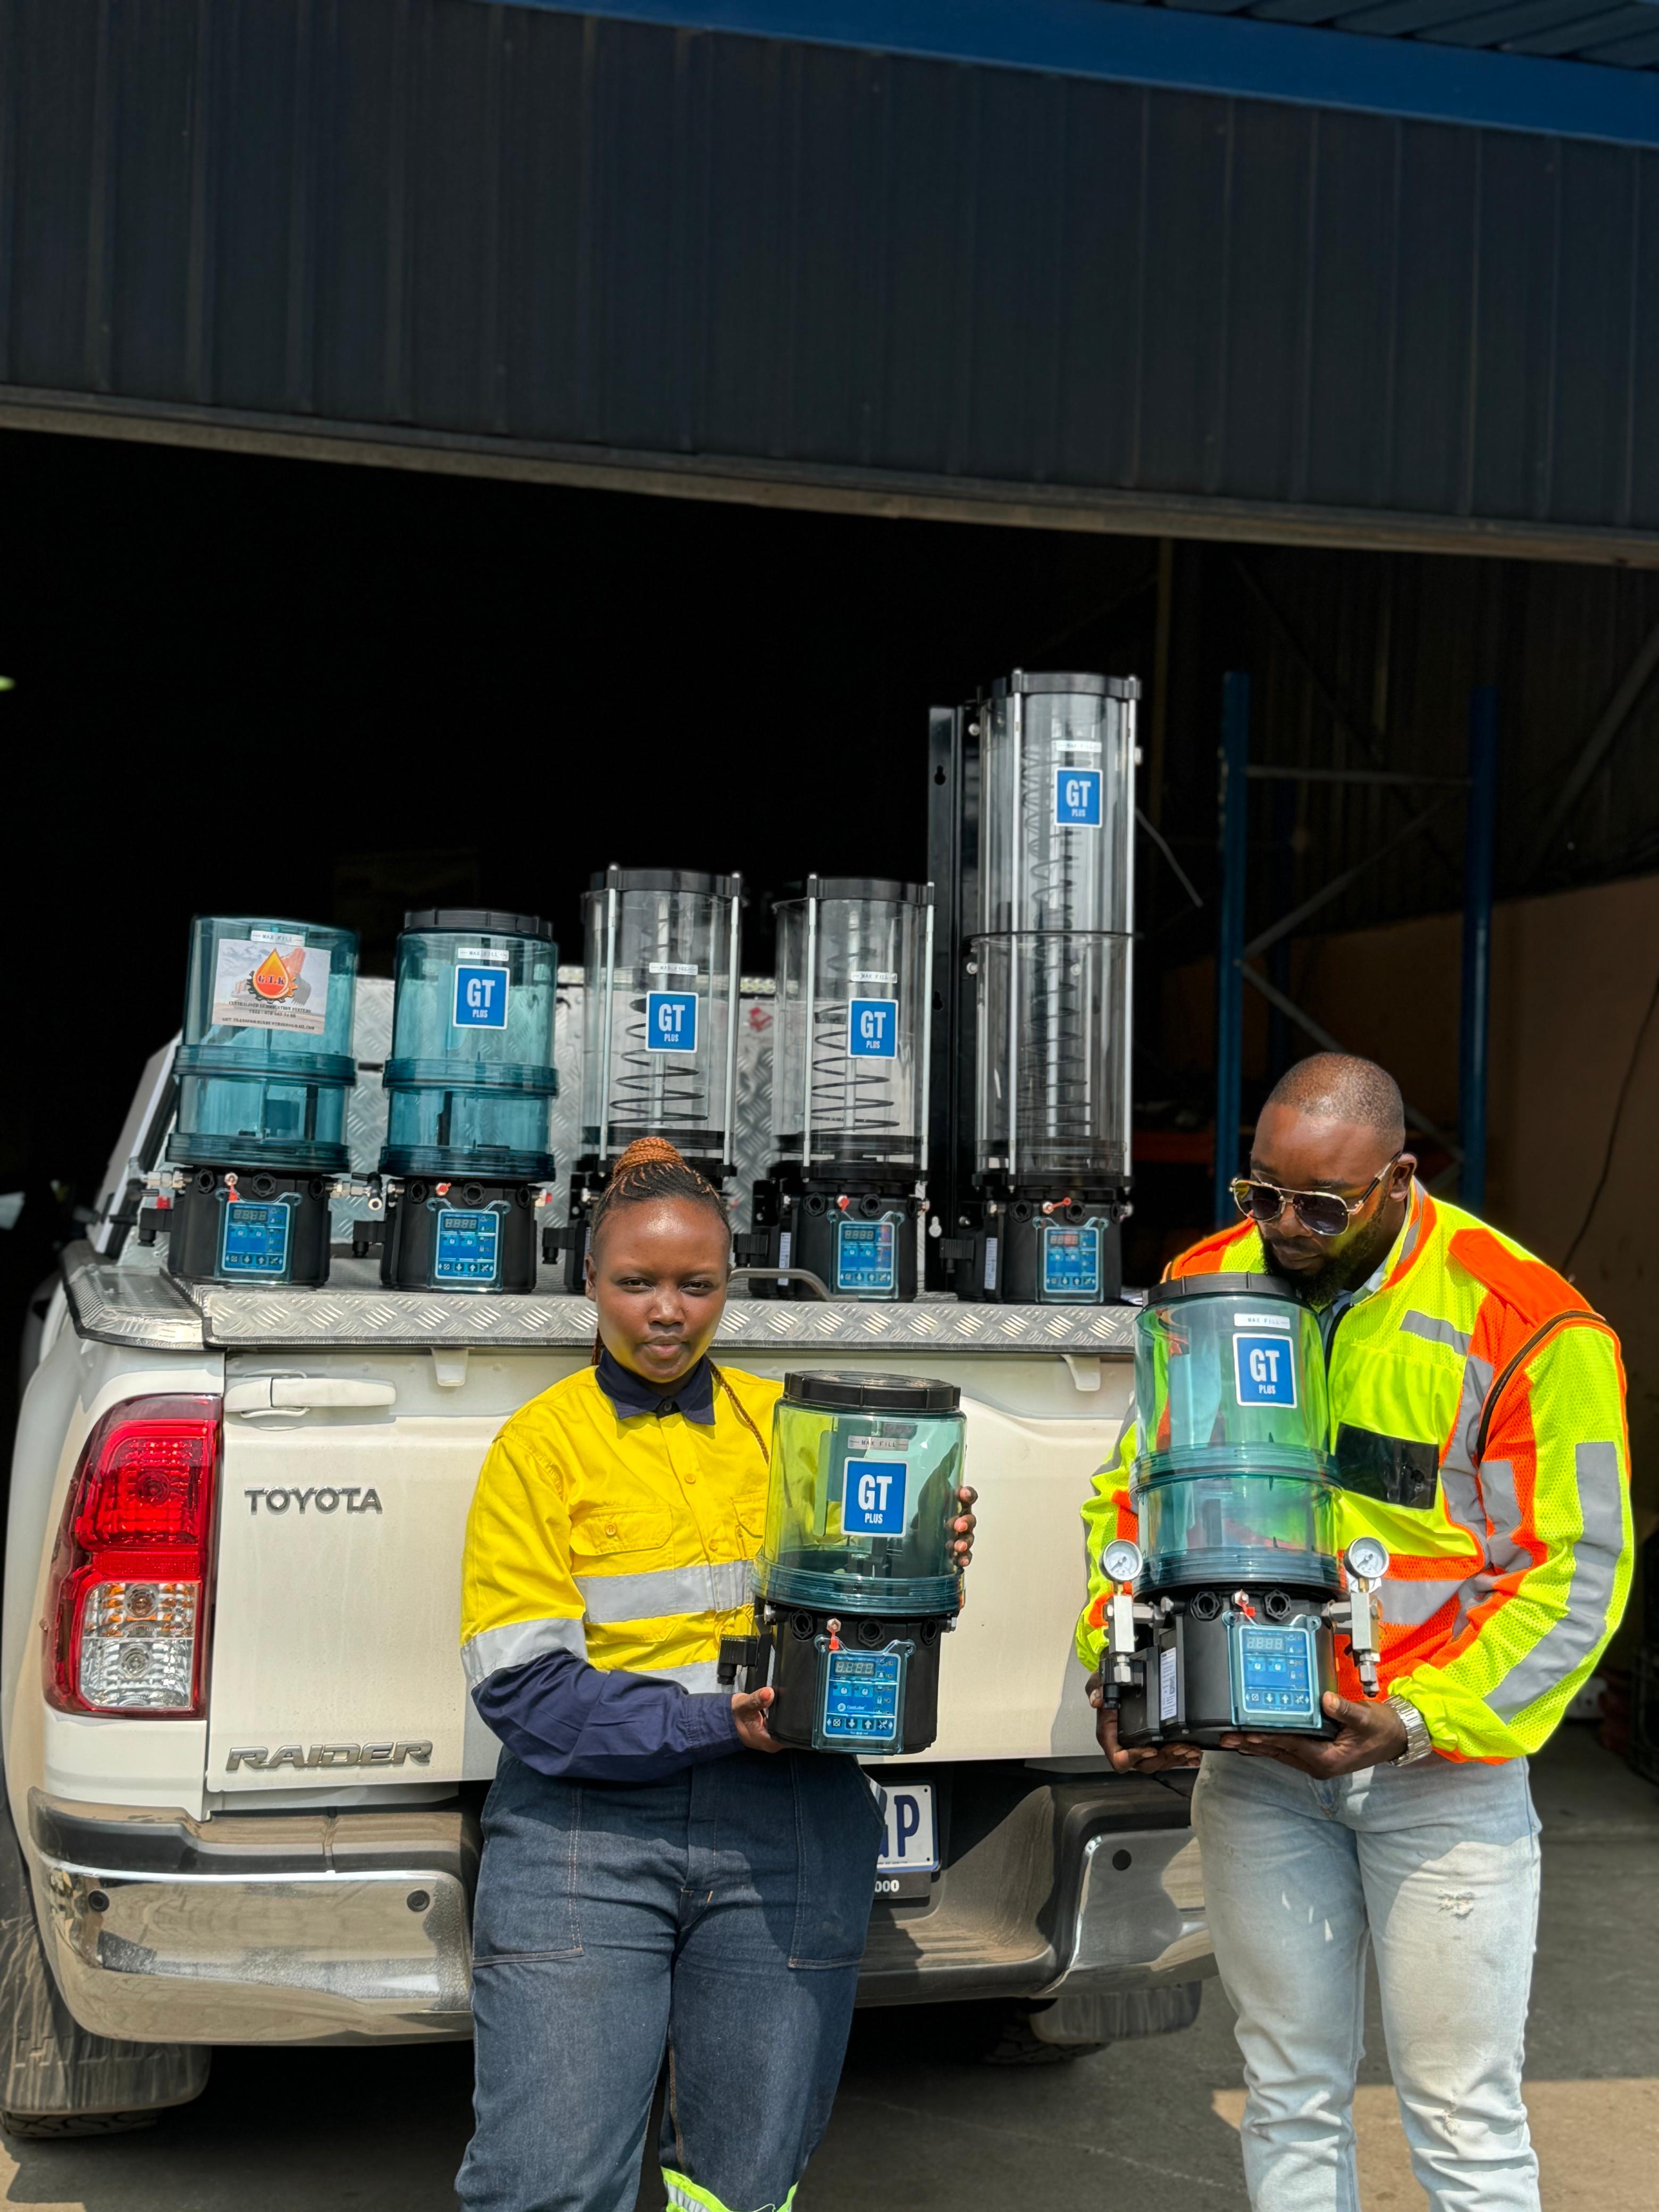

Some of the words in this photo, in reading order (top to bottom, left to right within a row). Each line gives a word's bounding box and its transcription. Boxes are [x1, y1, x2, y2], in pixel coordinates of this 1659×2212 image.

[1066, 779, 1091, 807] GT
[1071, 808, 1086, 817] PLUS
[467, 978, 495, 1007] GT
[472, 1009, 488, 1018] PLUS
[658, 1003, 685, 1032] GT
[860, 1010, 886, 1038] GT
[664, 1034, 679, 1042] PLUS
[866, 1041, 880, 1049] PLUS
[1250, 1348, 1280, 1382] GT
[1259, 1384, 1276, 1395] PLUS
[244, 1486, 383, 1515] TOYOTA
[858, 1474, 893, 1511] GT
[865, 1513, 883, 1524] PLUS
[225, 1740, 433, 1772] RAIDER
